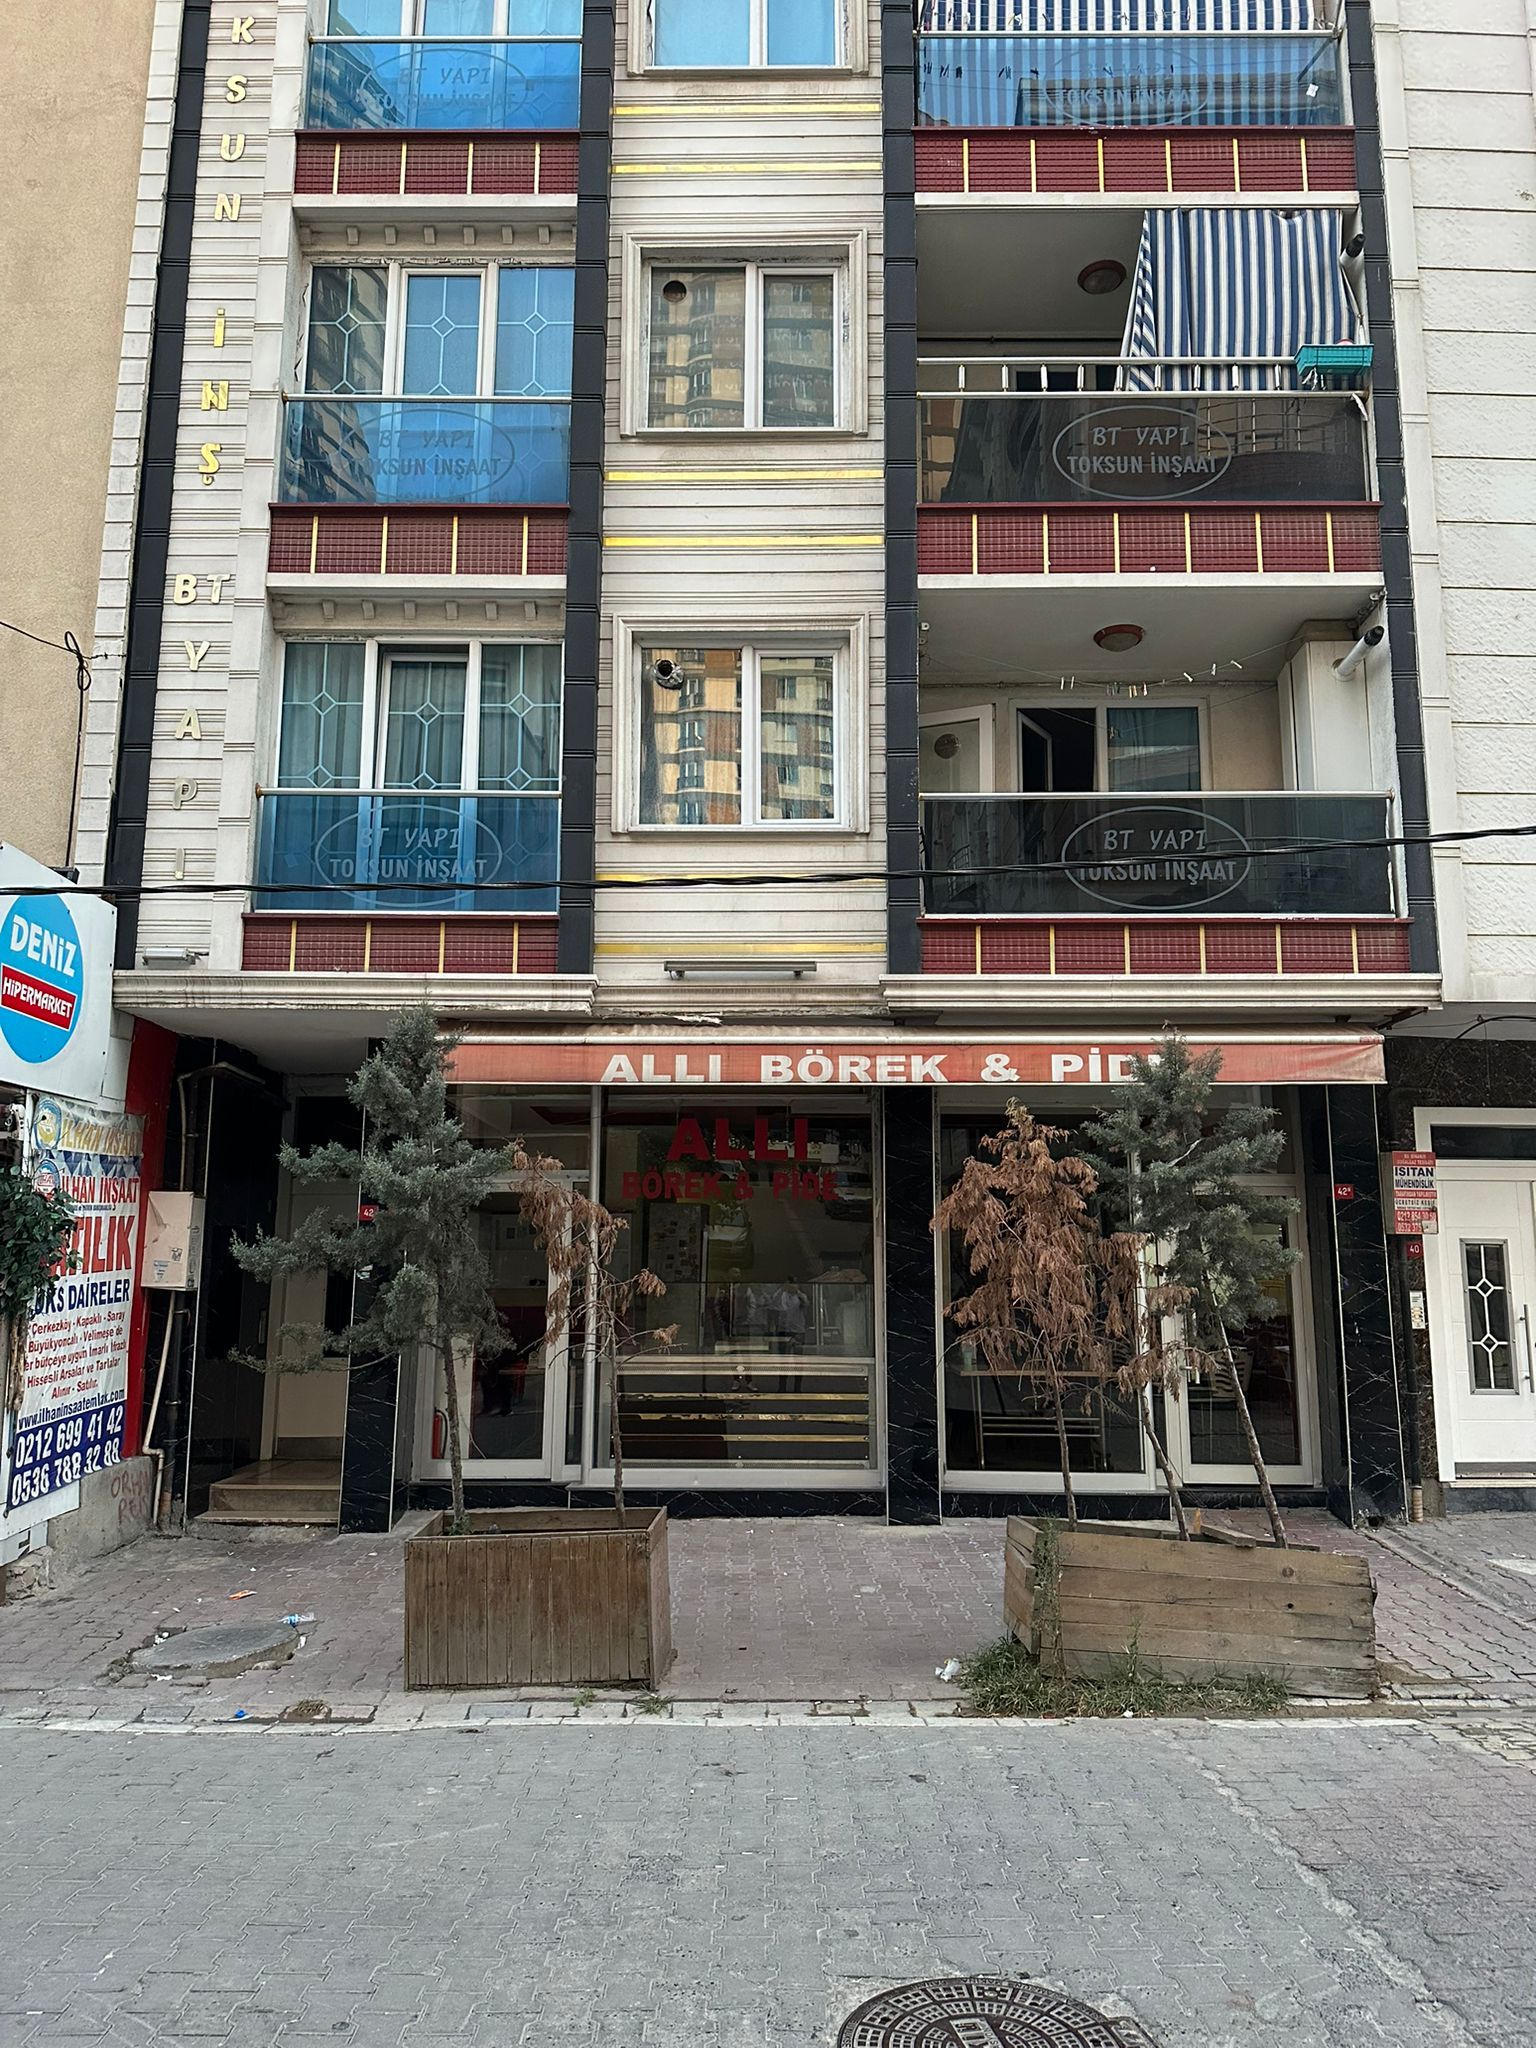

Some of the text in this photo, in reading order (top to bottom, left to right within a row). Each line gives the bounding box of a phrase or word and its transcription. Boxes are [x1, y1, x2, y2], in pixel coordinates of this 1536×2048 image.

[423, 430, 476, 449] YAPI
[1092, 426, 1191, 447] BT YAPI
[352, 453, 502, 480] OKSUN İNŞAAT
[1067, 452, 1218, 478] TOKSUN İNŞAAT
[172, 573, 232, 605] BT
[405, 827, 460, 848] YAPI
[1103, 829, 1208, 850] BT YAPI
[417, 854, 488, 883] İNŞAAT
[600, 1047, 1166, 1083] ALLI BÖREK & PİD
[666, 1117, 808, 1162] ALLI
[621, 1167, 841, 1201] BÖREK & PİDE
[1395, 1167, 1434, 1177] ISITAN
[99, 1174, 140, 1211] İNŞAAT
[363, 1208, 375, 1217] 42
[1409, 1245, 1420, 1254] 40
[68, 1276, 131, 1311] DAİRELER
[76, 1313, 102, 1328] Kapaklı
[107, 1311, 126, 1322] Saray
[24, 1357, 34, 1373] er
[27, 1371, 59, 1389] Hissesli
[60, 1364, 86, 1381] Arsalar
[86, 1364, 95, 1374] ve
[15, 1404, 124, 1469] 0212 699 41 42
[11, 1462, 51, 1507] 0536
[84, 1443, 103, 1475] 32
[103, 1436, 121, 1467] 88
